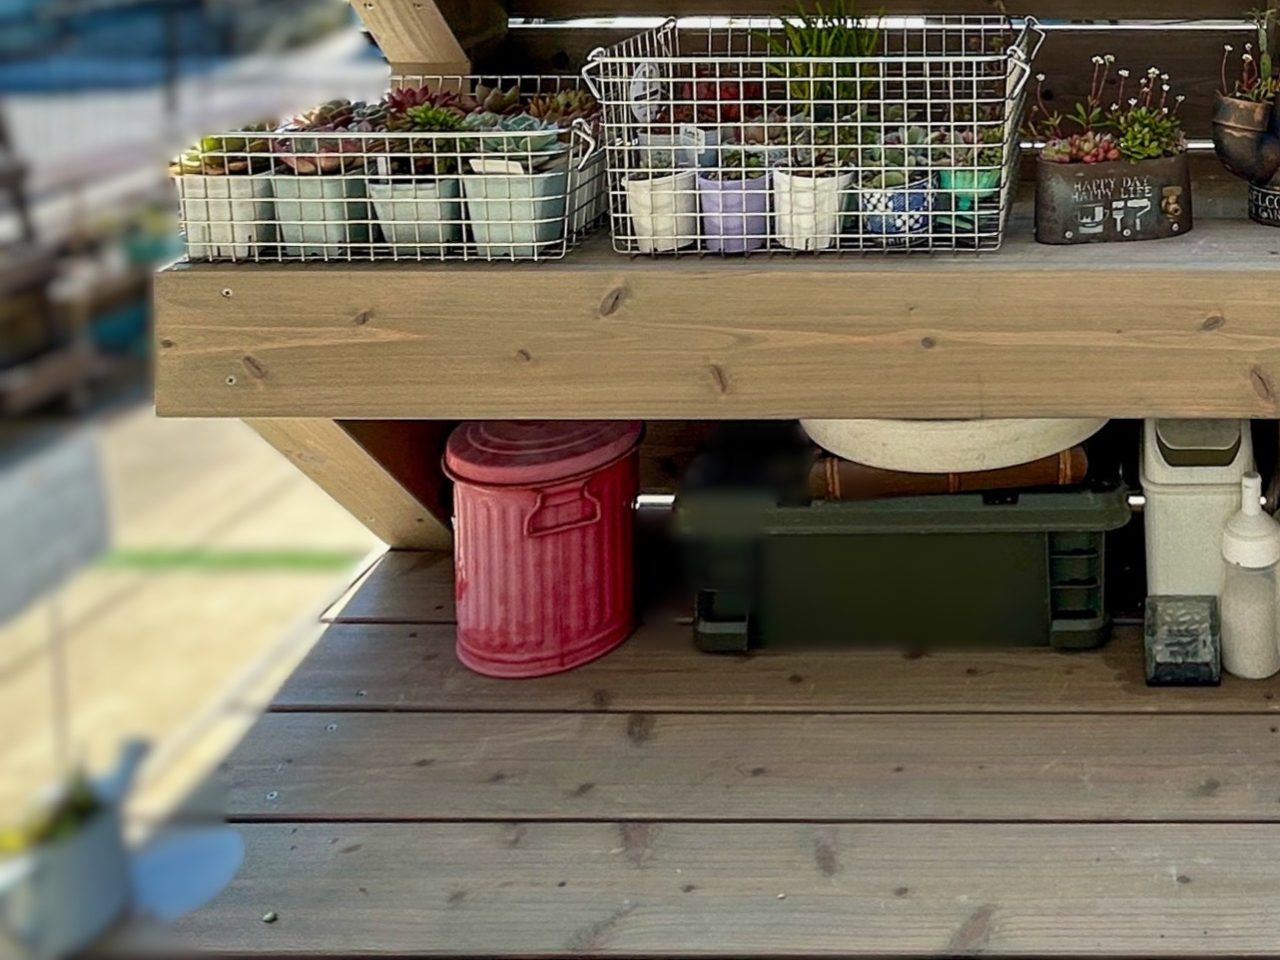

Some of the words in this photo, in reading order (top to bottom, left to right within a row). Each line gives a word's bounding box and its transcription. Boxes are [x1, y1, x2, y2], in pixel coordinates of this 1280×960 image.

[1073, 177, 1116, 193] HAPPY
[1122, 176, 1149, 188] DAY
[1071, 187, 1113, 202] HAPPY
[1120, 186, 1153, 199] LIFE
